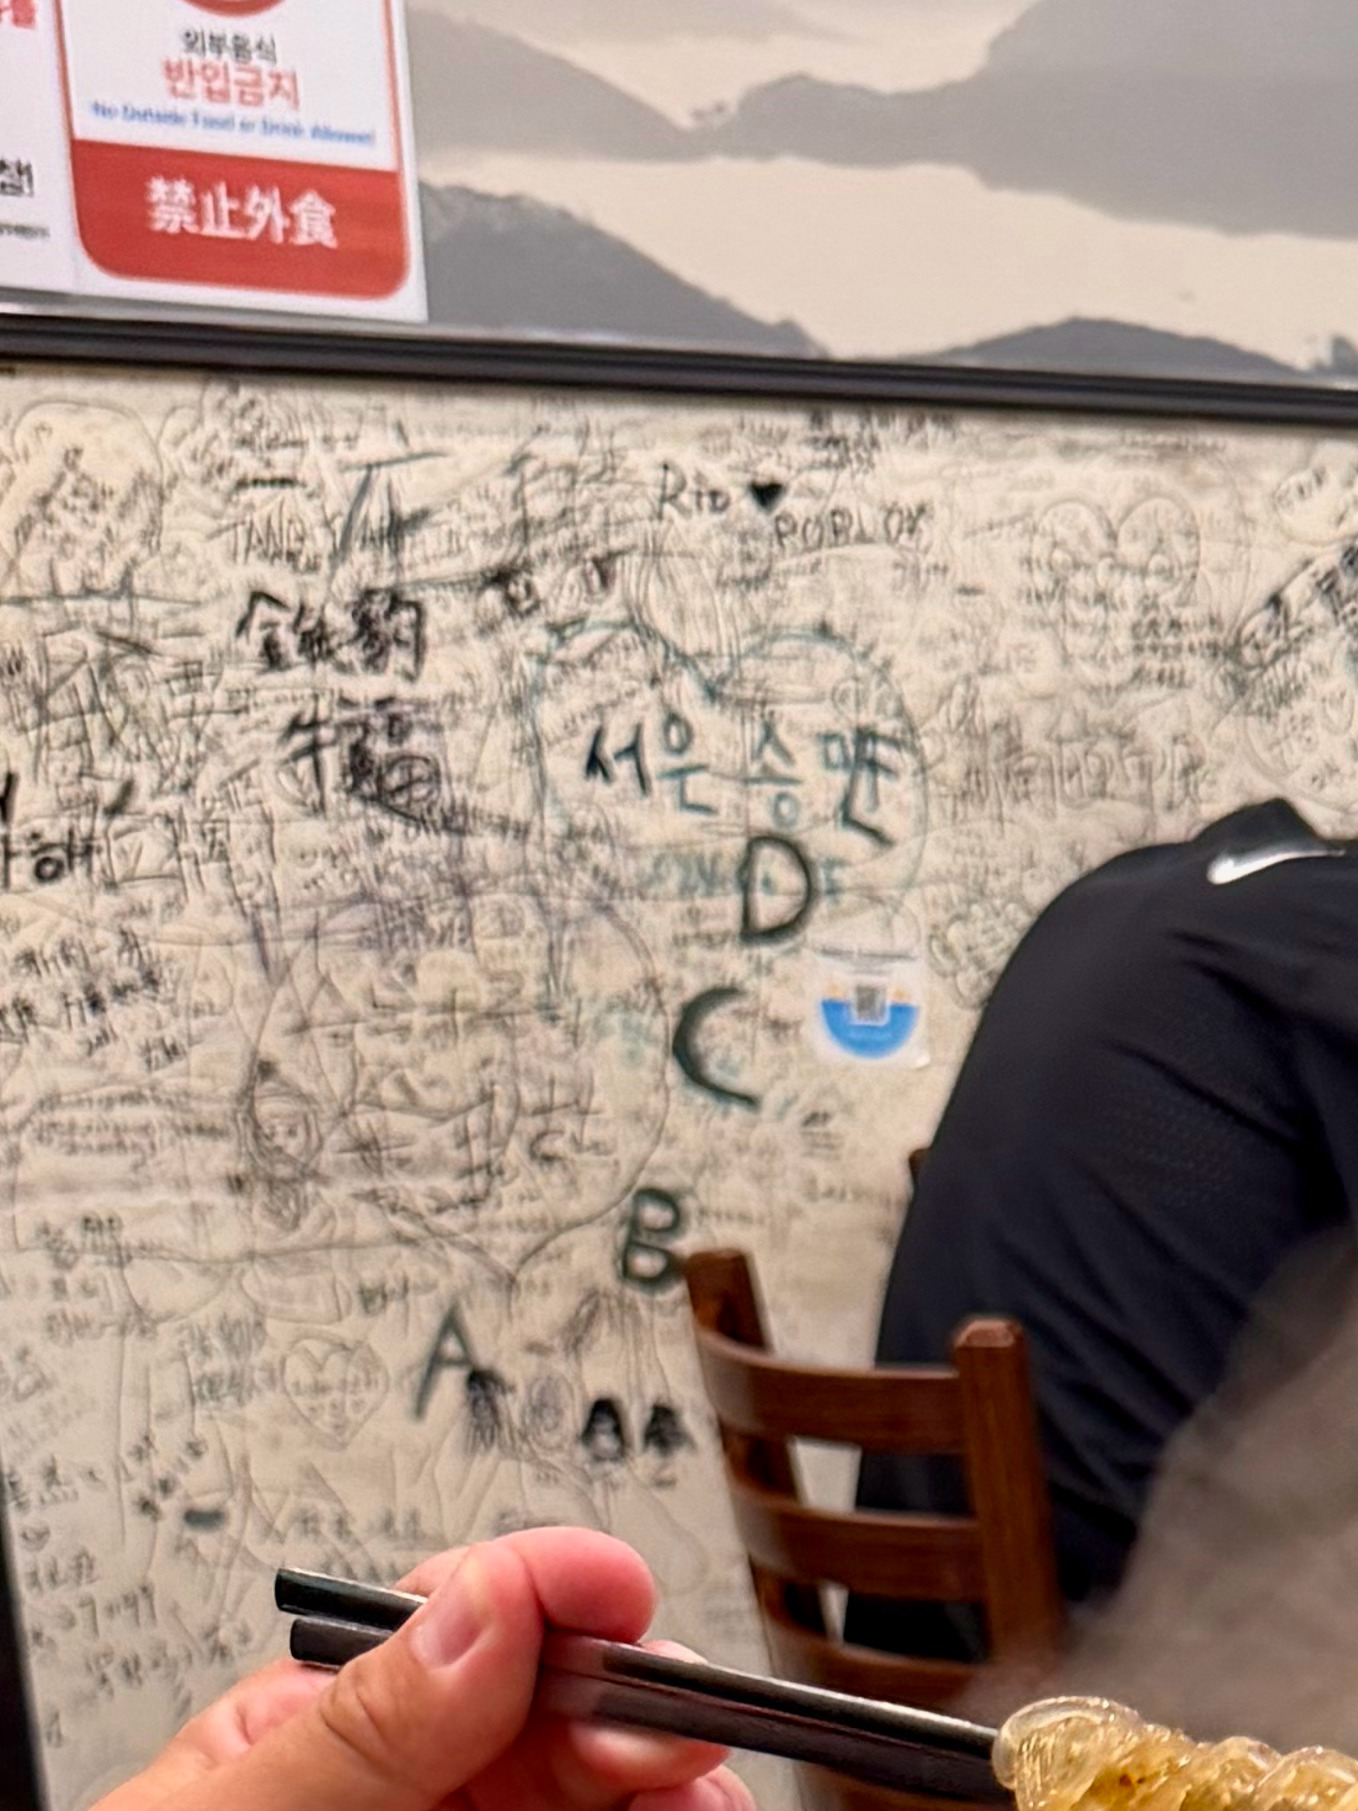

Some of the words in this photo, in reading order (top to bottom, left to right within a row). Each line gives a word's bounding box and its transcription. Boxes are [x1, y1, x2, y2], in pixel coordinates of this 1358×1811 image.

[162, 57, 301, 110] 반입금지
[146, 175, 338, 249] 禁止外食
